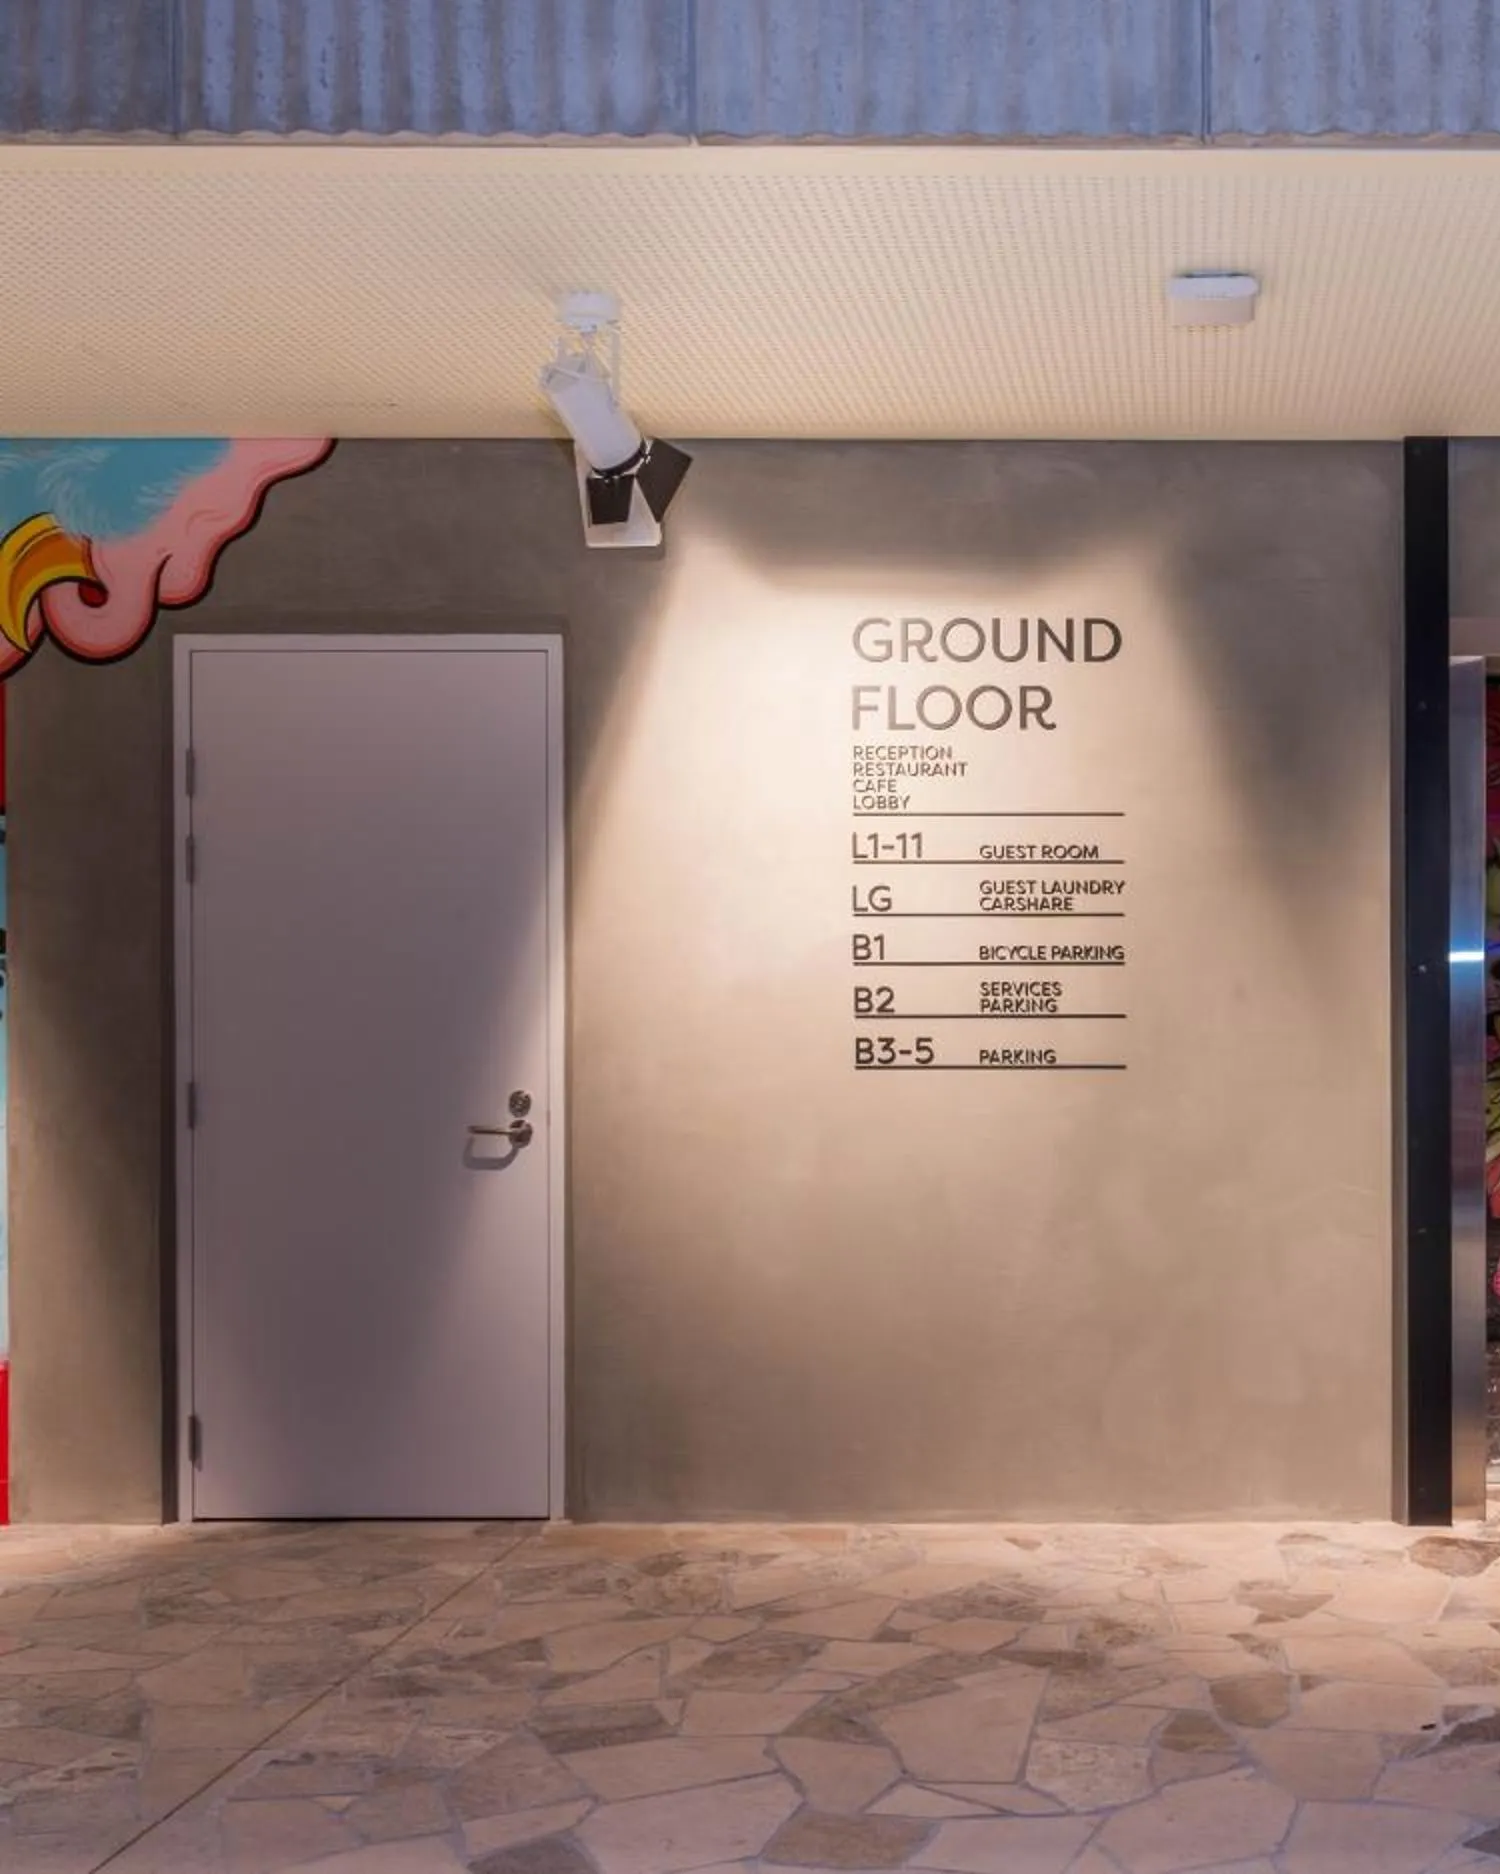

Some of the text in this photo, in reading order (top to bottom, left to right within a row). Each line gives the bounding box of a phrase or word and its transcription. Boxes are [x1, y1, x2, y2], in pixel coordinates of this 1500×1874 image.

[852, 617, 1123, 663] GROUND
[851, 684, 1057, 731] FLOOR
[853, 746, 953, 760] RECEPTION
[853, 762, 968, 777] RESTAURANT
[853, 779, 897, 793] CAFE
[853, 795, 911, 810] LOBBY
[852, 832, 1099, 859] L1-11 GUEST ROOM
[979, 880, 1125, 895] GUEST LAUNDRY
[852, 885, 893, 912] LG
[979, 897, 1074, 911] CARSHARE
[852, 934, 1125, 961] B1 BICYCLE PARKING
[980, 982, 1063, 997] SERVICES
[854, 986, 895, 1013] B2
[980, 998, 1058, 1013] PARKING
[855, 1037, 1057, 1064] B3-5 PARKING
